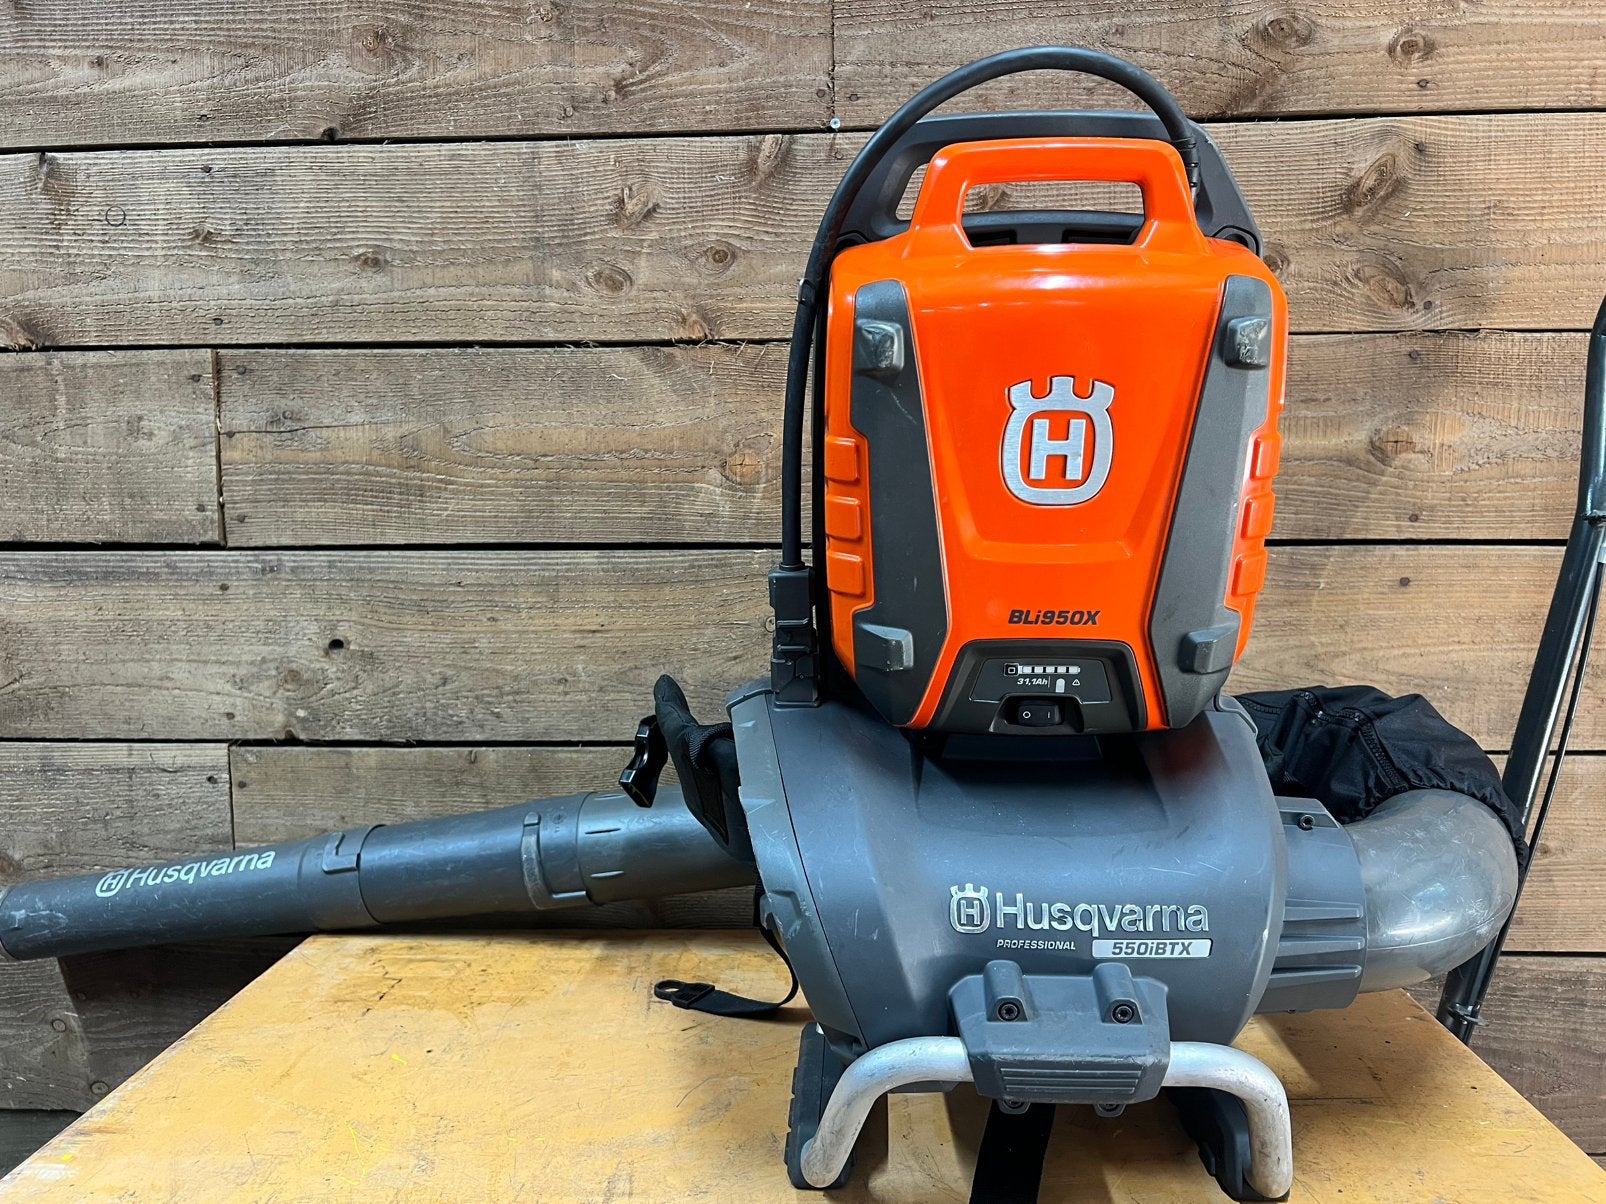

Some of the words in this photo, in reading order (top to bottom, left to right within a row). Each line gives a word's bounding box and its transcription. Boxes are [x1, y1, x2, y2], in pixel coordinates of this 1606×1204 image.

[1007, 609, 1101, 626] BLi950X
[125, 850, 276, 889] Husqvarna
[995, 892, 1210, 937] Husqvarna
[996, 938, 1077, 951] PROFESSIONAL
[1111, 941, 1193, 956] 550iBTX
